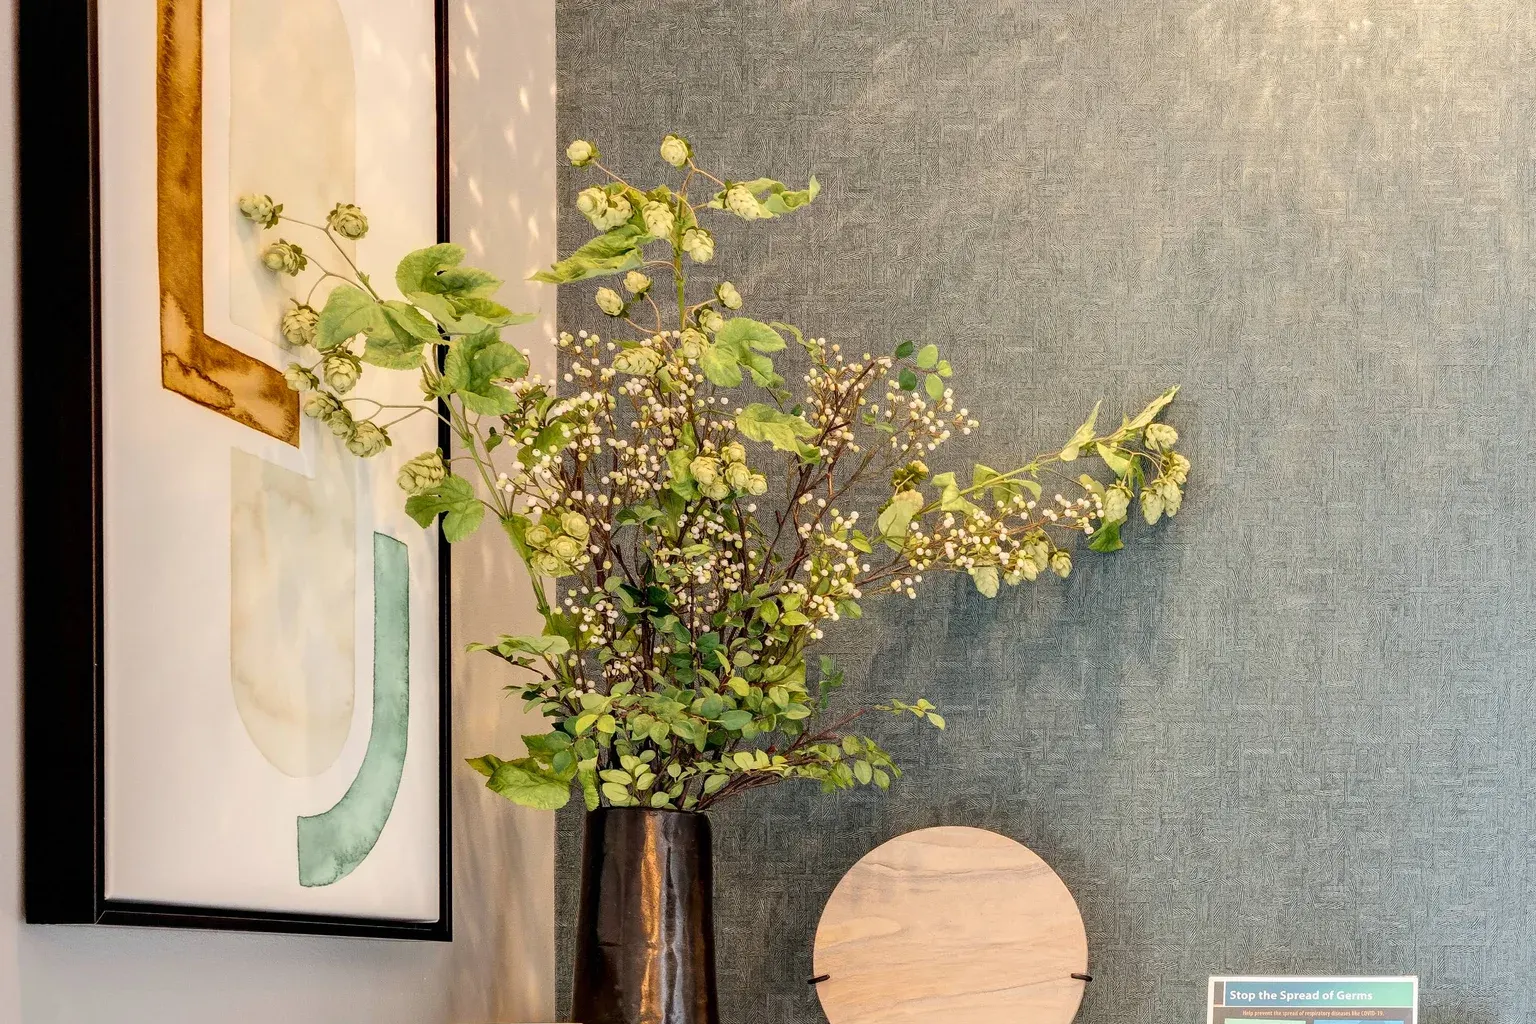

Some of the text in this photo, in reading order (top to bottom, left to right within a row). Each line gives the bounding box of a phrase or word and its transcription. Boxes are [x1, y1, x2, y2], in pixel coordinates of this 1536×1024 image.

[1229, 989, 1373, 1002] Stop the Spread of Germs
